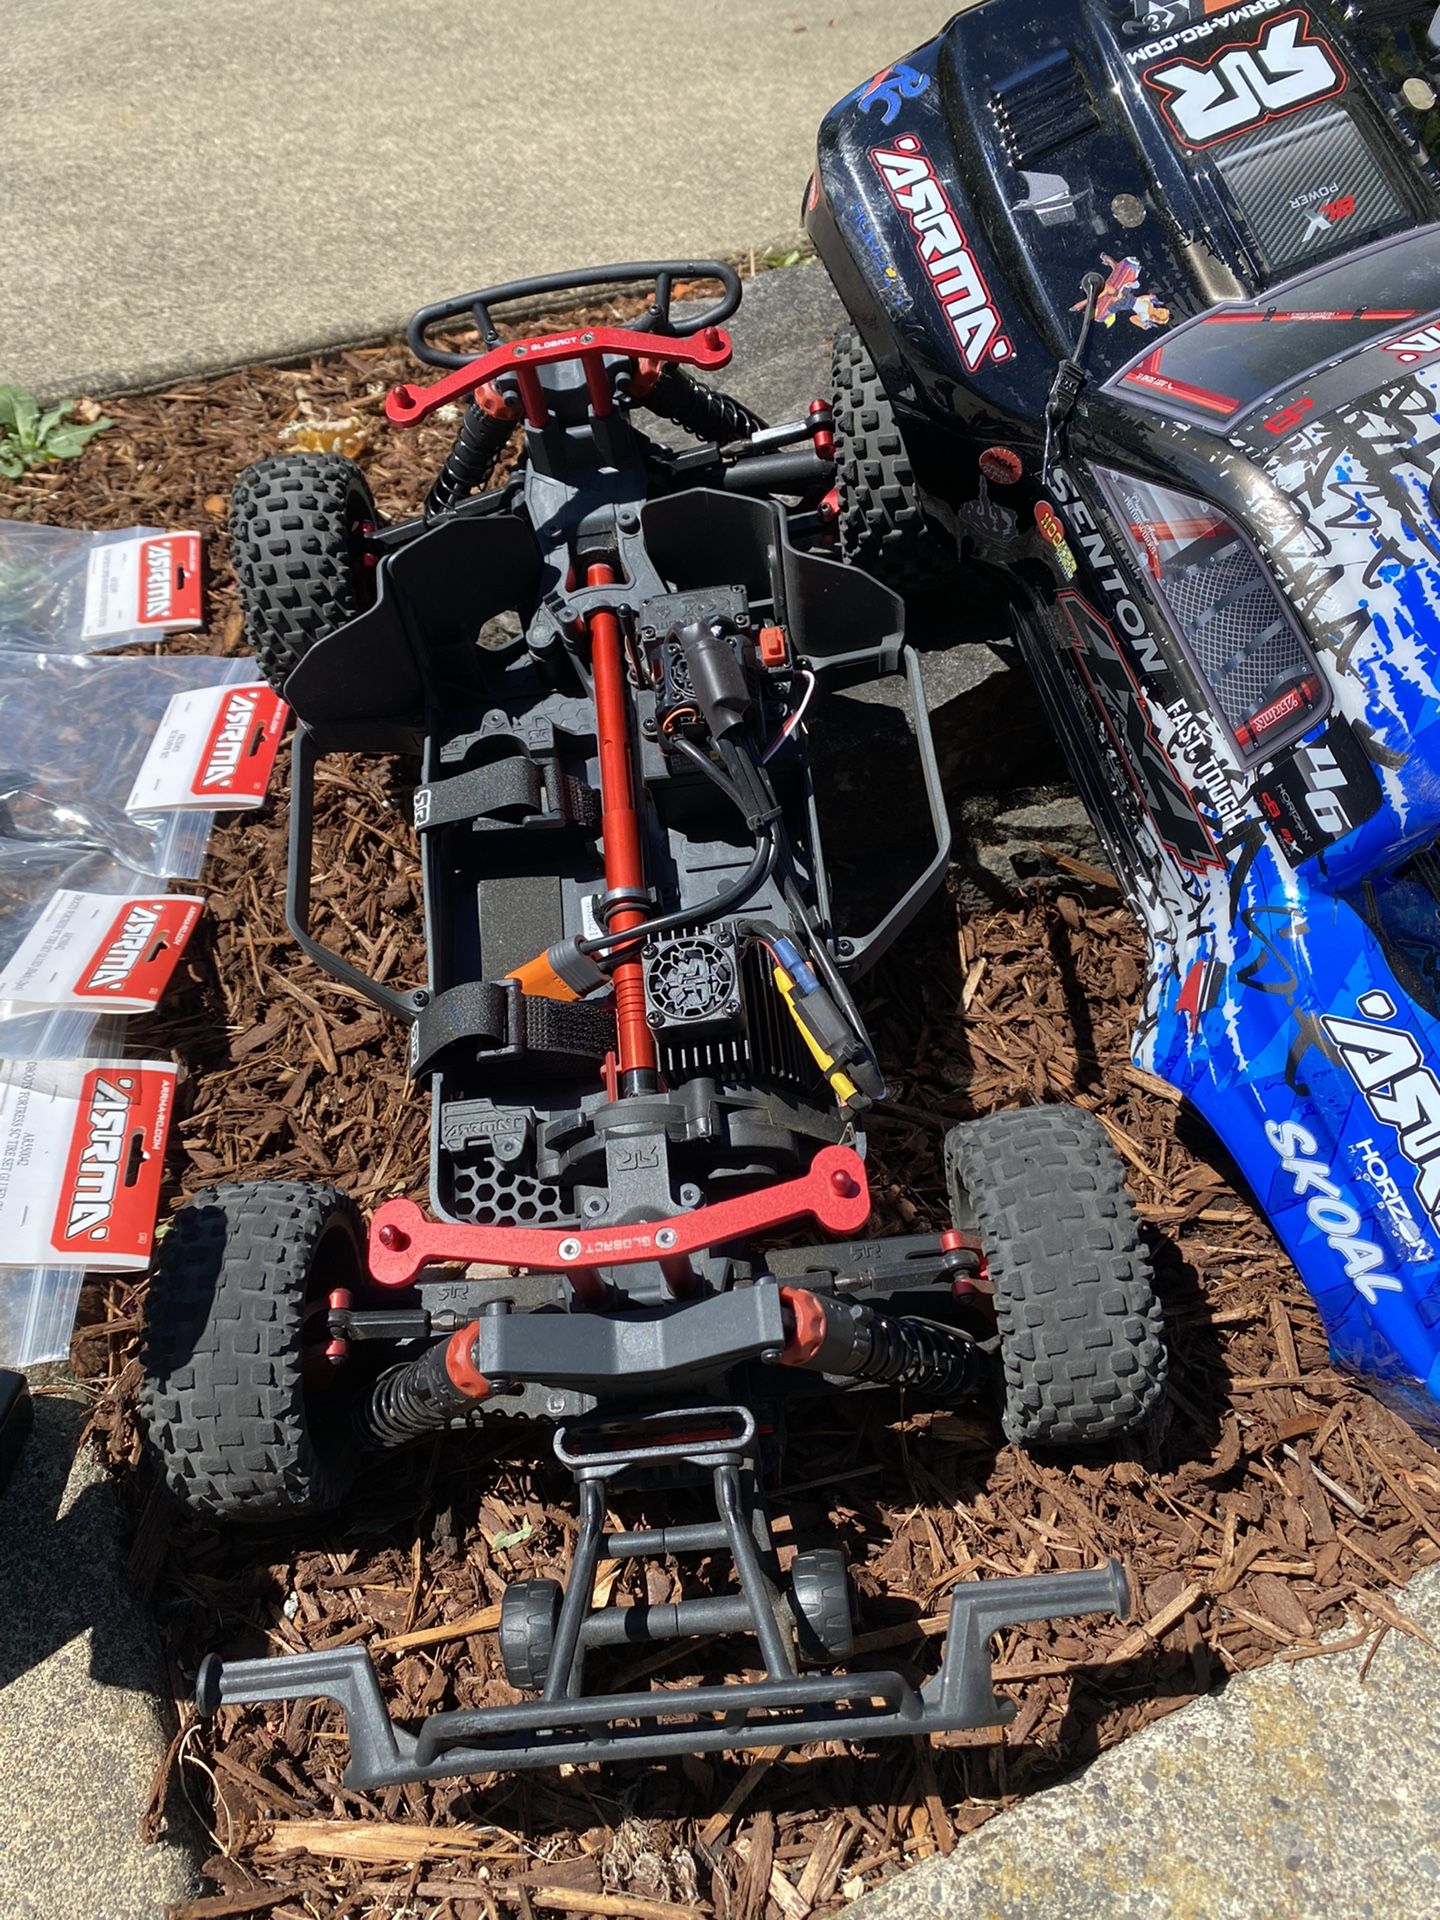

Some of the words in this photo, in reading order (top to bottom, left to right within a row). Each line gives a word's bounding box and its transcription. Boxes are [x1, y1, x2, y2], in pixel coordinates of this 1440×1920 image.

[1290, 182, 1339, 209] POWER
[870, 133, 1013, 373] ARRMA
[1047, 468, 1167, 673] SENTON
[202, 691, 260, 788] ARRMA
[1256, 694, 1298, 732] ARRMA
[1196, 757, 1246, 837] TOUGH.
[1305, 745, 1353, 834] 46
[87, 904, 165, 990] ARRMA
[65, 1077, 134, 1241] ARRMA
[152, 1080, 171, 1151] ARRMA-RC.COM
[1265, 1118, 1403, 1306] SKOAL
